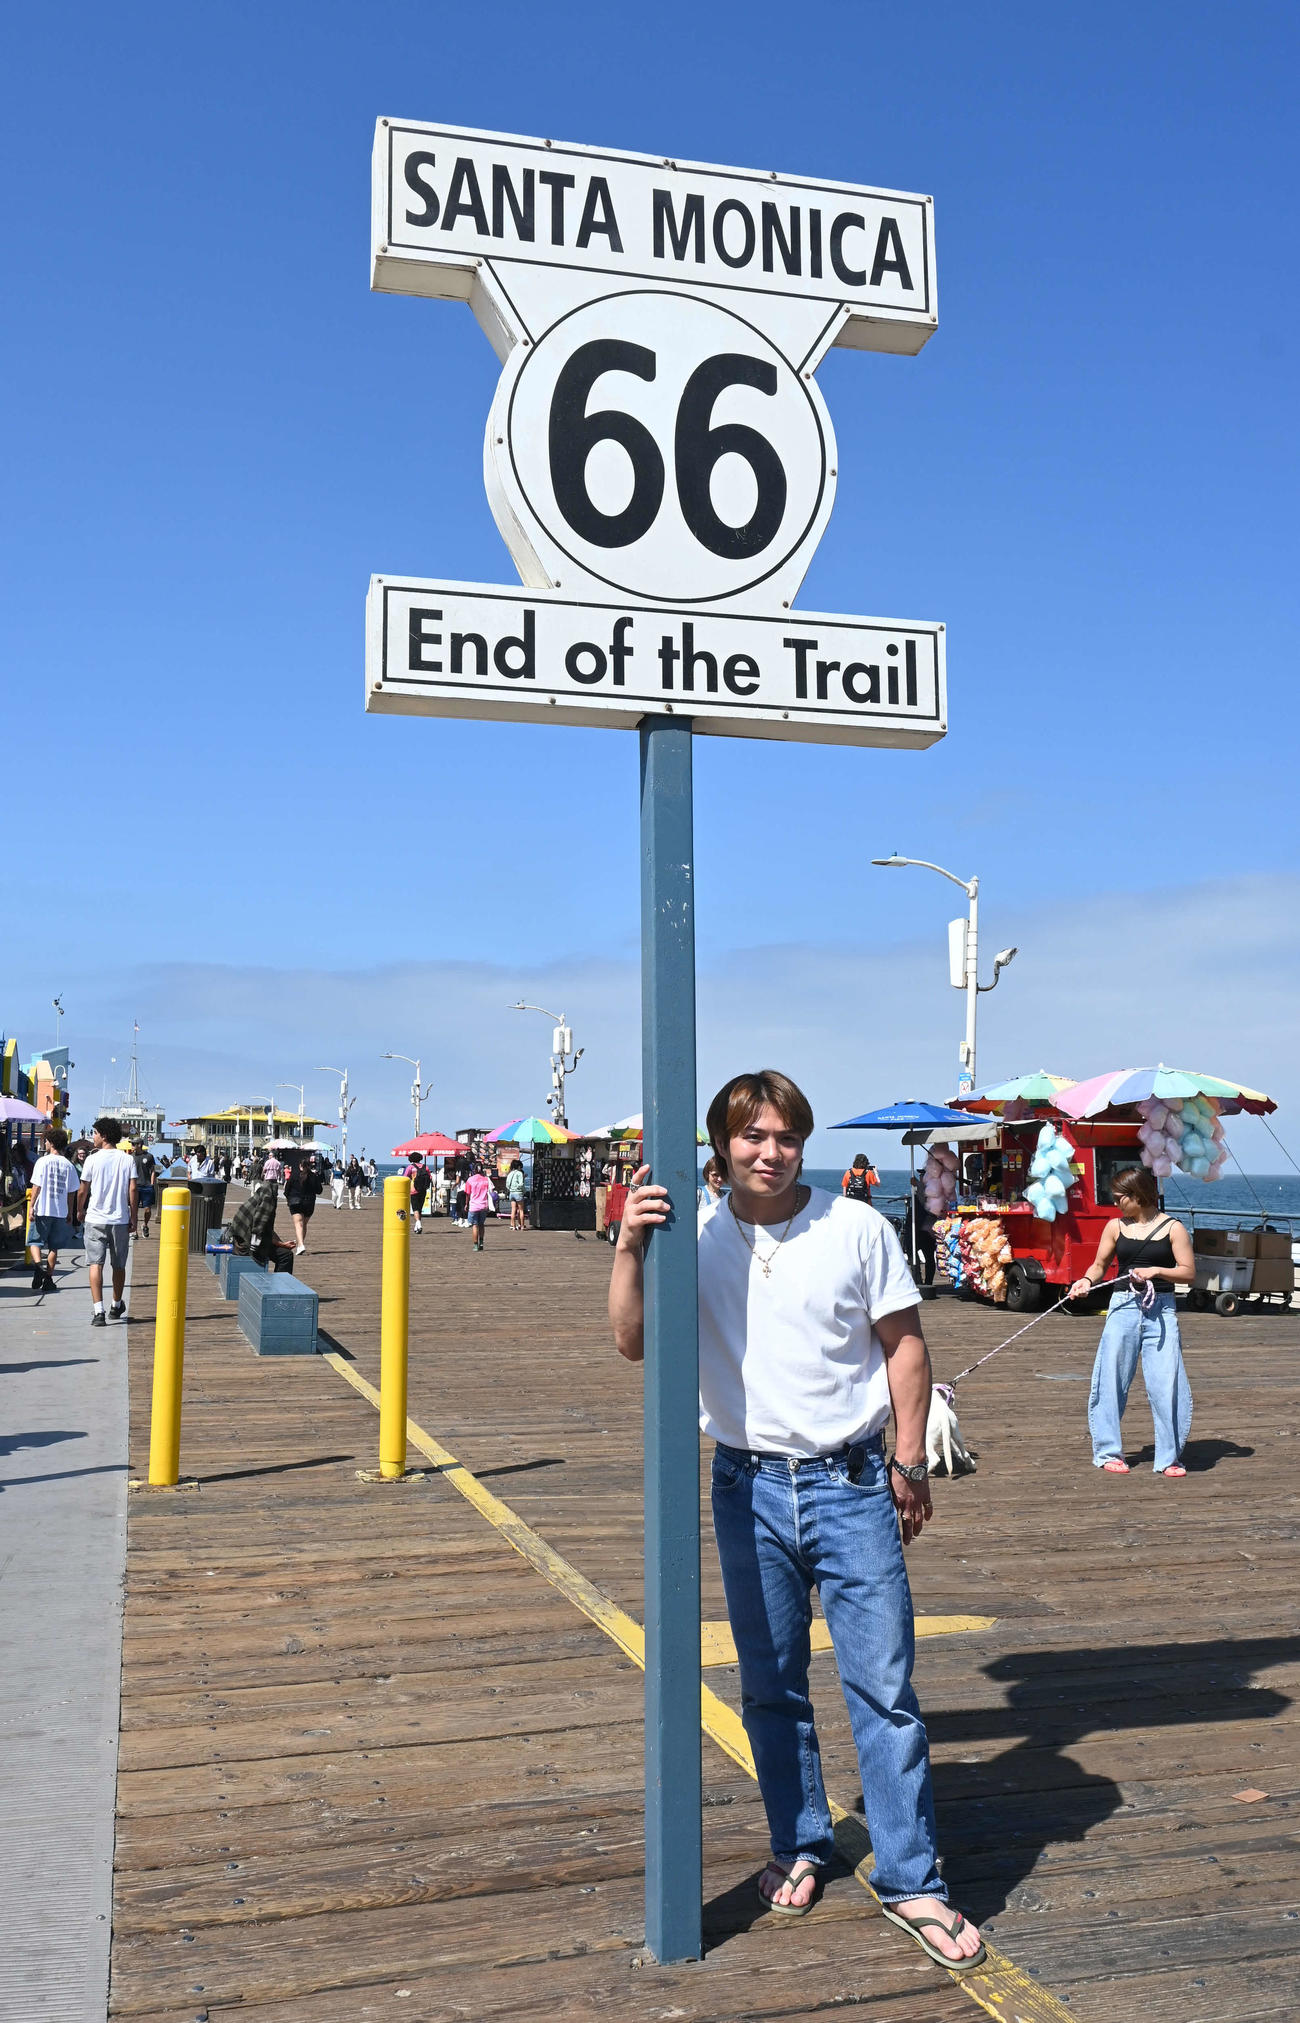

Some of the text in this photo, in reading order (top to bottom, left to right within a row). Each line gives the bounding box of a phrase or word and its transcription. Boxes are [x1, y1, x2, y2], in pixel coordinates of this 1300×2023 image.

[405, 151, 914, 290] SANTA MONICA
[549, 339, 787, 560] 66
[409, 607, 918, 707] End of the Trail
